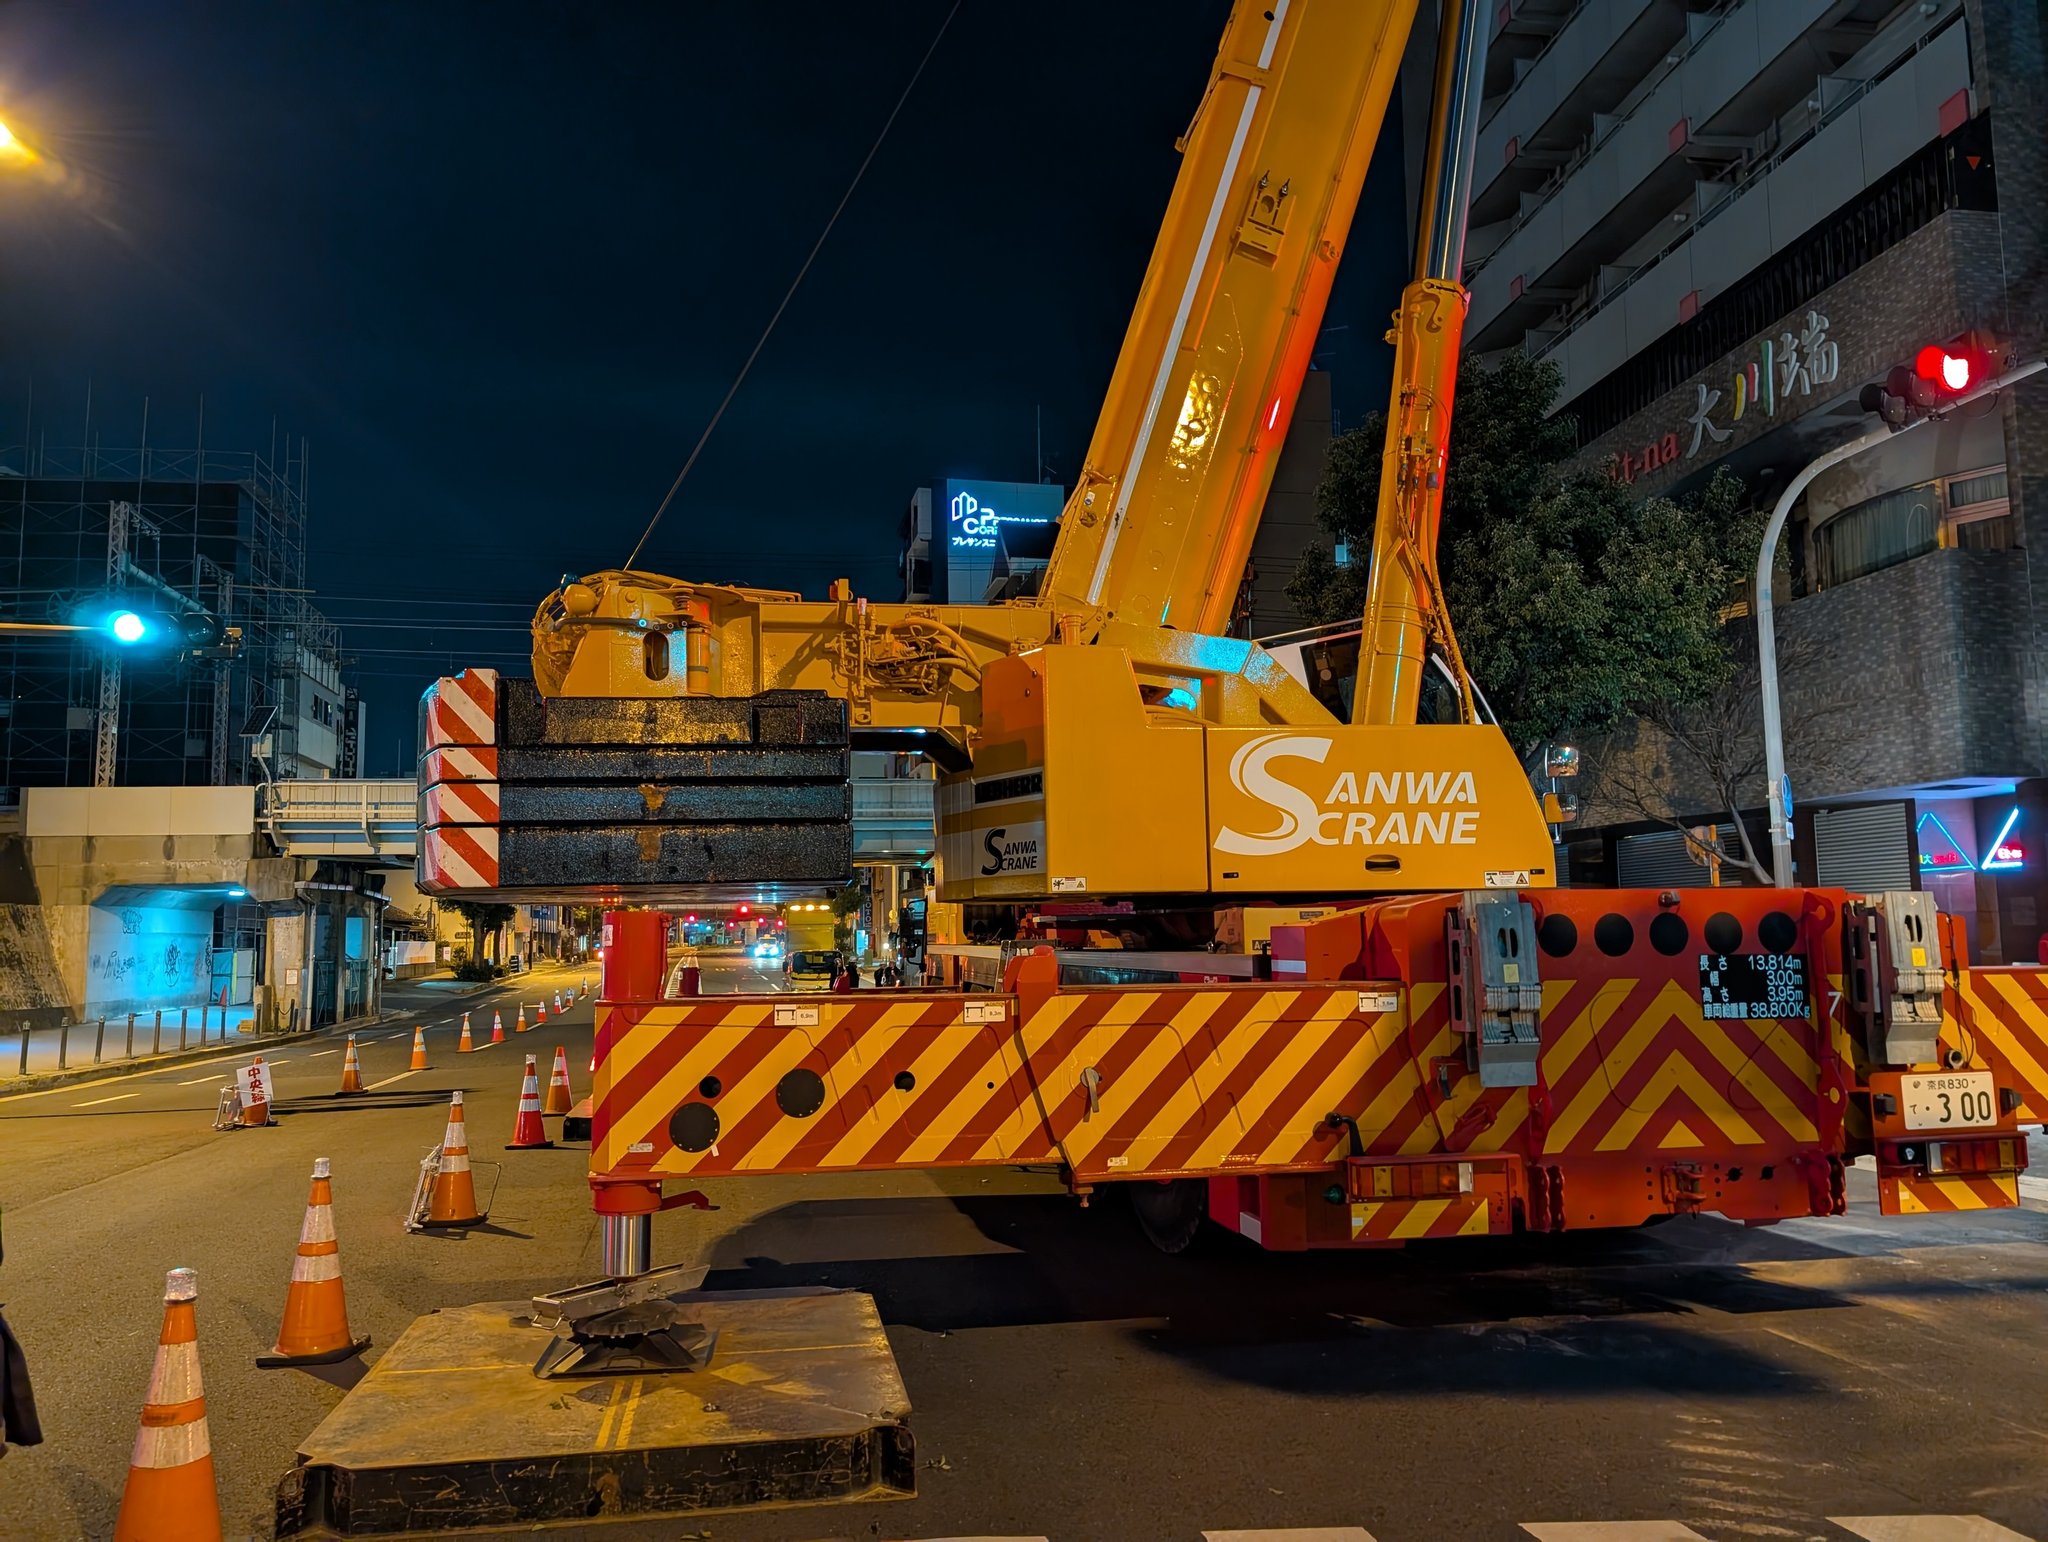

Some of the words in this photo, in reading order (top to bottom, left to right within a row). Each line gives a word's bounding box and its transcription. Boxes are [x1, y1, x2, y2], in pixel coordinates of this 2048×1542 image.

[1686, 310, 1839, 460] 大川端
[1315, 811, 1481, 846] CRANE
[1001, 855, 1038, 871] CRANE
[1748, 954, 1802, 971] 13.814m
[1766, 970, 1803, 986] 3.00m
[1767, 986, 1804, 1002] 3.95m
[1827, 991, 1842, 1018] 7
